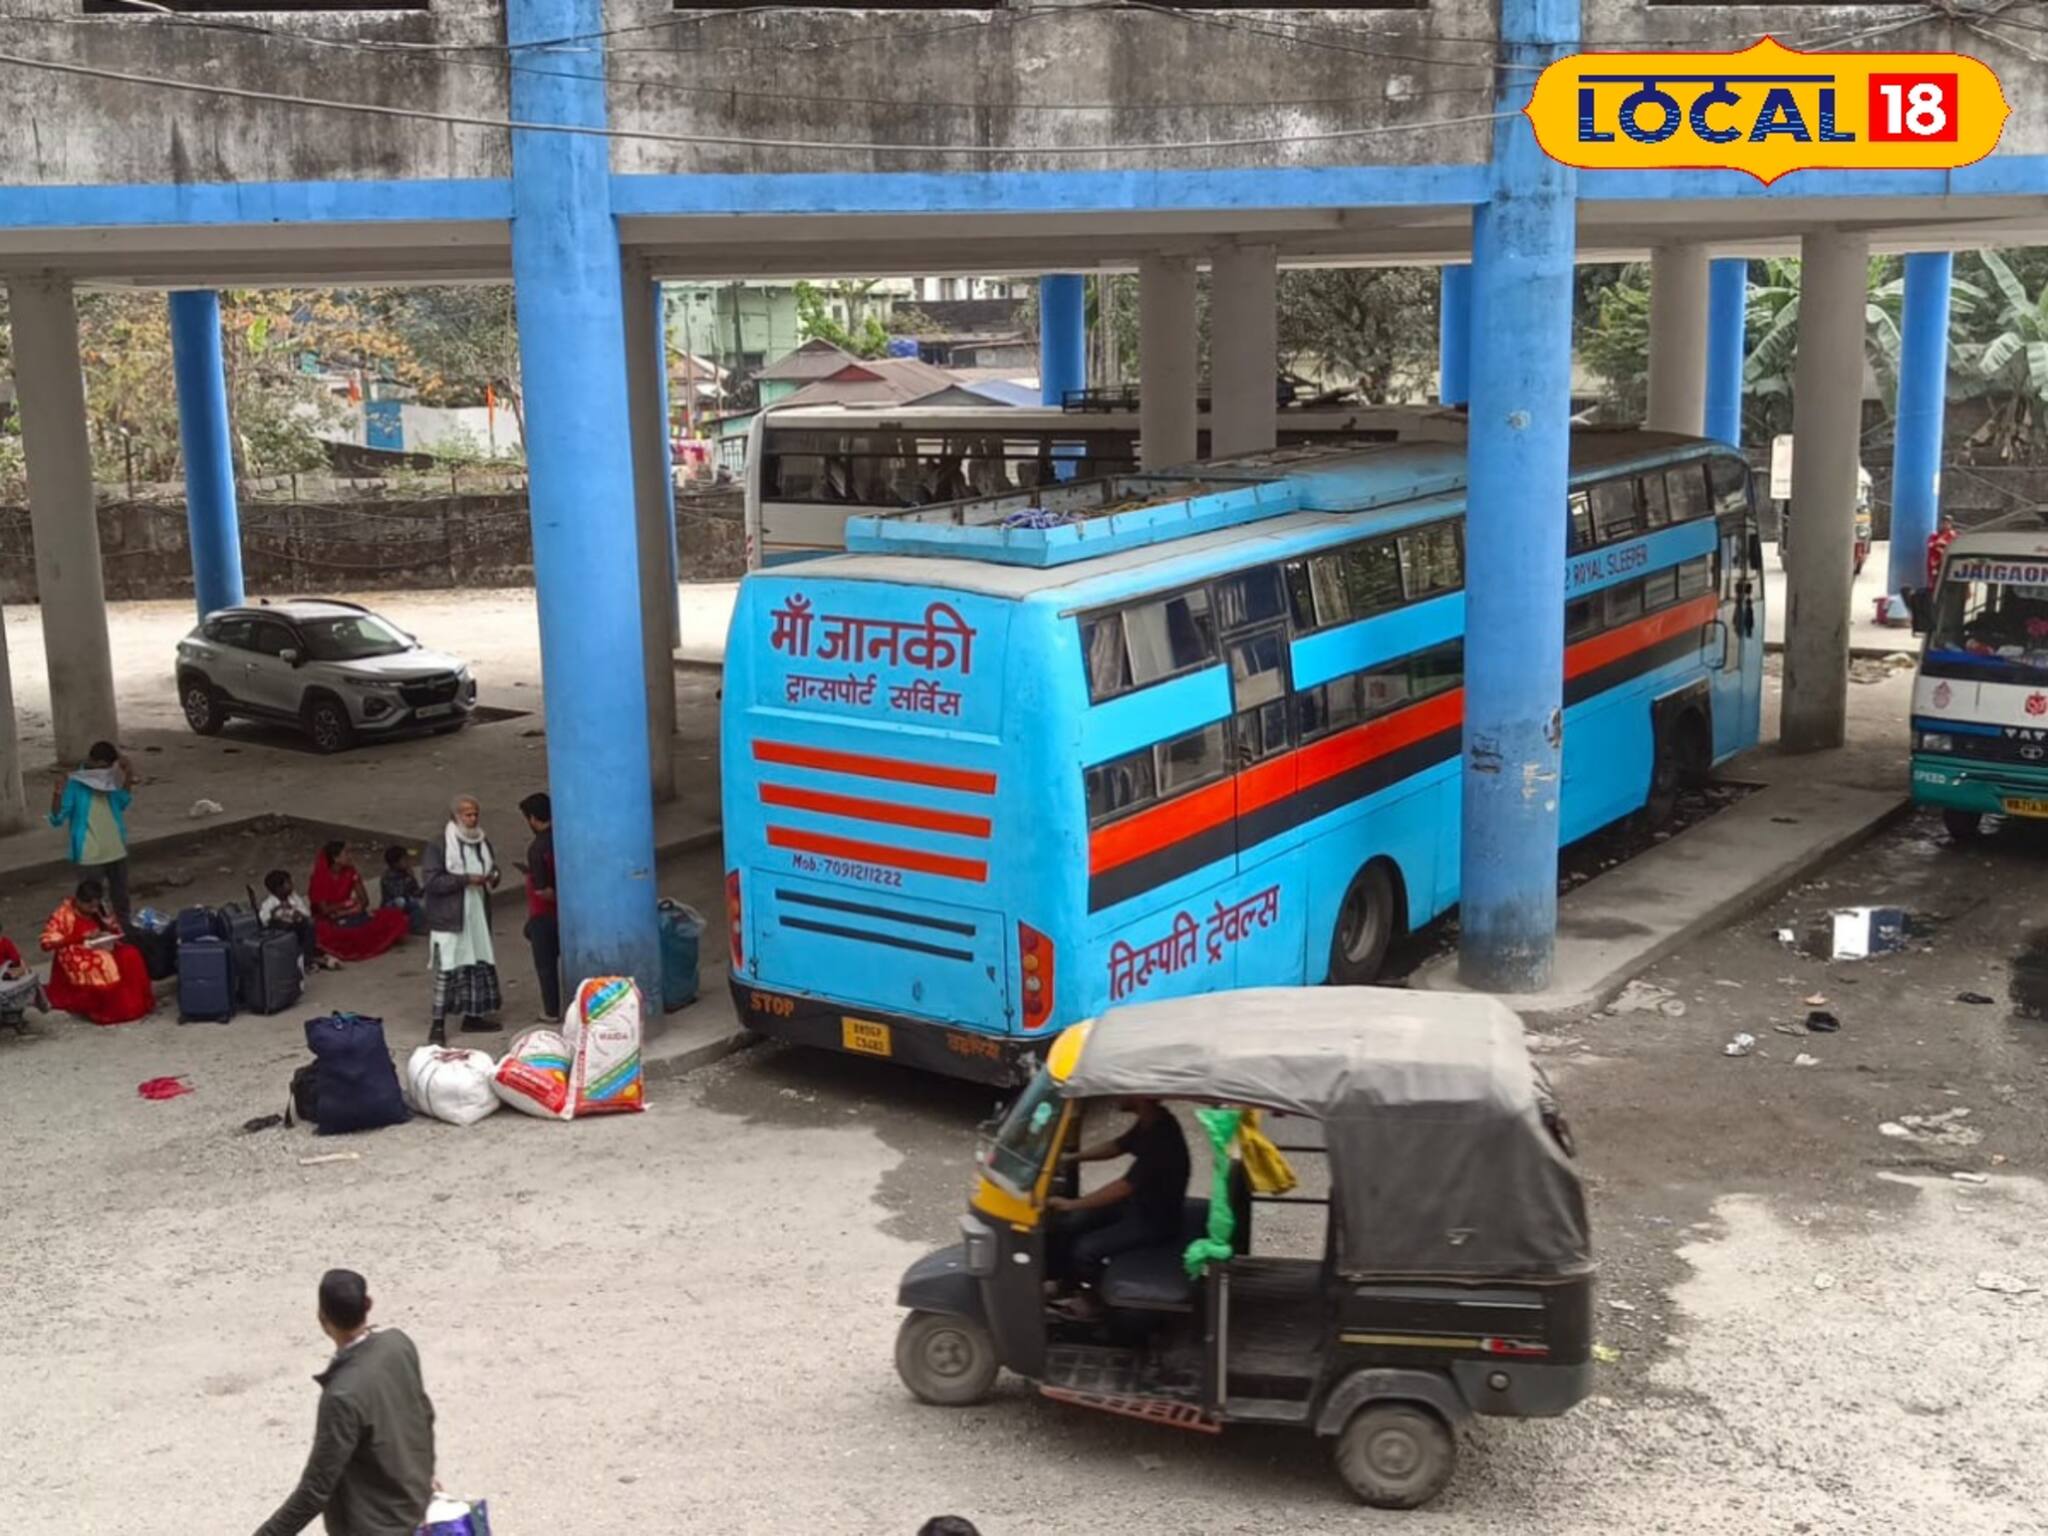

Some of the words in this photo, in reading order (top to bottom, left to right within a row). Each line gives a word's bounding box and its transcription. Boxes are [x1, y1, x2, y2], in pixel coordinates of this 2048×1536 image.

[1574, 557, 1605, 587] ROYAL
[1607, 544, 1648, 574] SLEEPER
[816, 602, 976, 674] जानकी
[889, 679, 961, 716] सर्विस
[751, 991, 794, 1017] STOP
